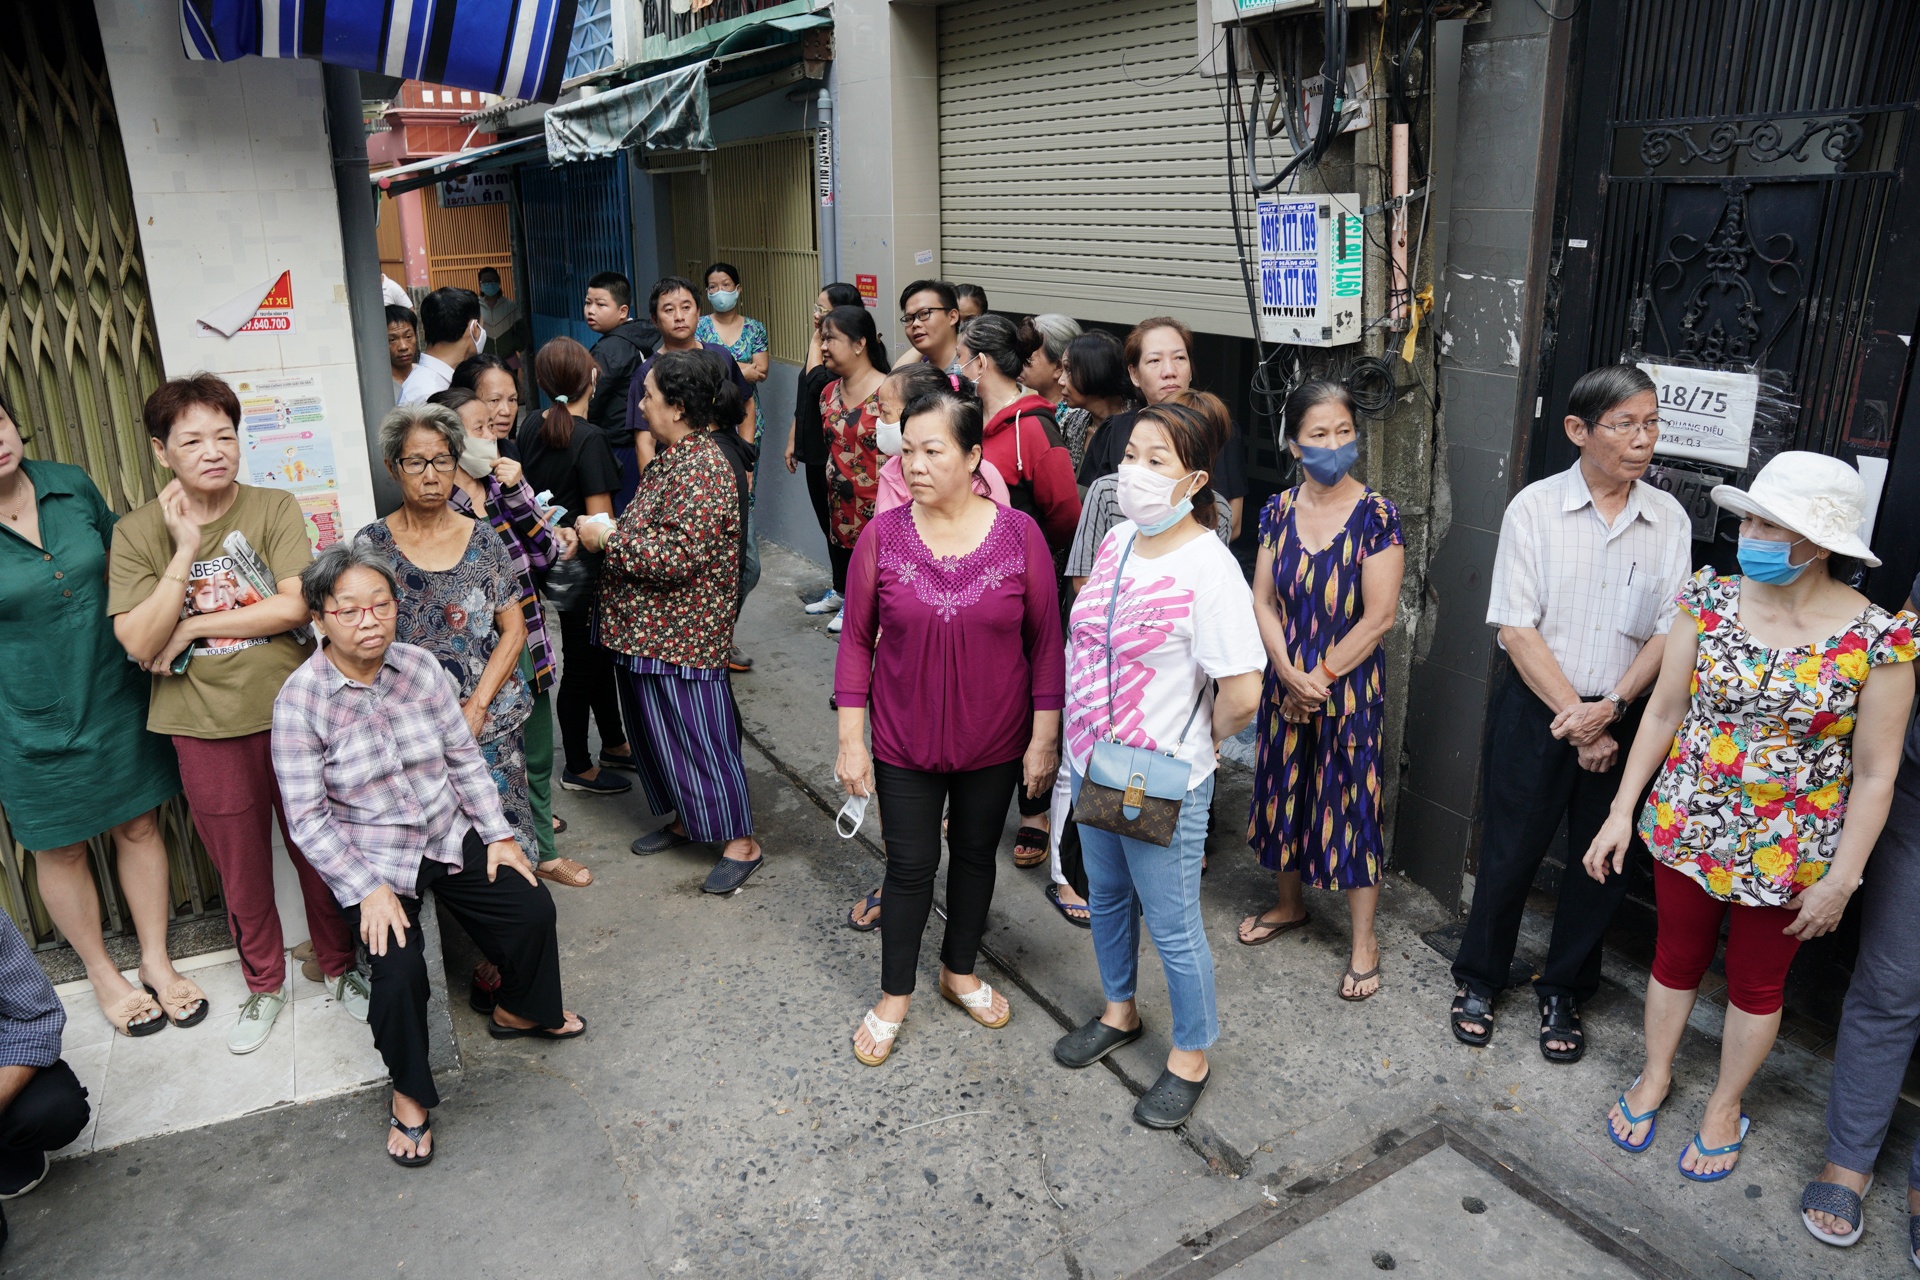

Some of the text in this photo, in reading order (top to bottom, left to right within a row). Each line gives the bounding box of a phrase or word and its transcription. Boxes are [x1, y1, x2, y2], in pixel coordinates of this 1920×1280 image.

[1261, 212, 1316, 252] 0916.177.199
[1263, 268, 1317, 306] 0916.177.199
[276, 297, 288, 305] XE
[1660, 384, 1728, 413] 18/75
[1686, 438, 1701, 447] Q.3
[205, 636, 269, 655] YOURSELF BABE
